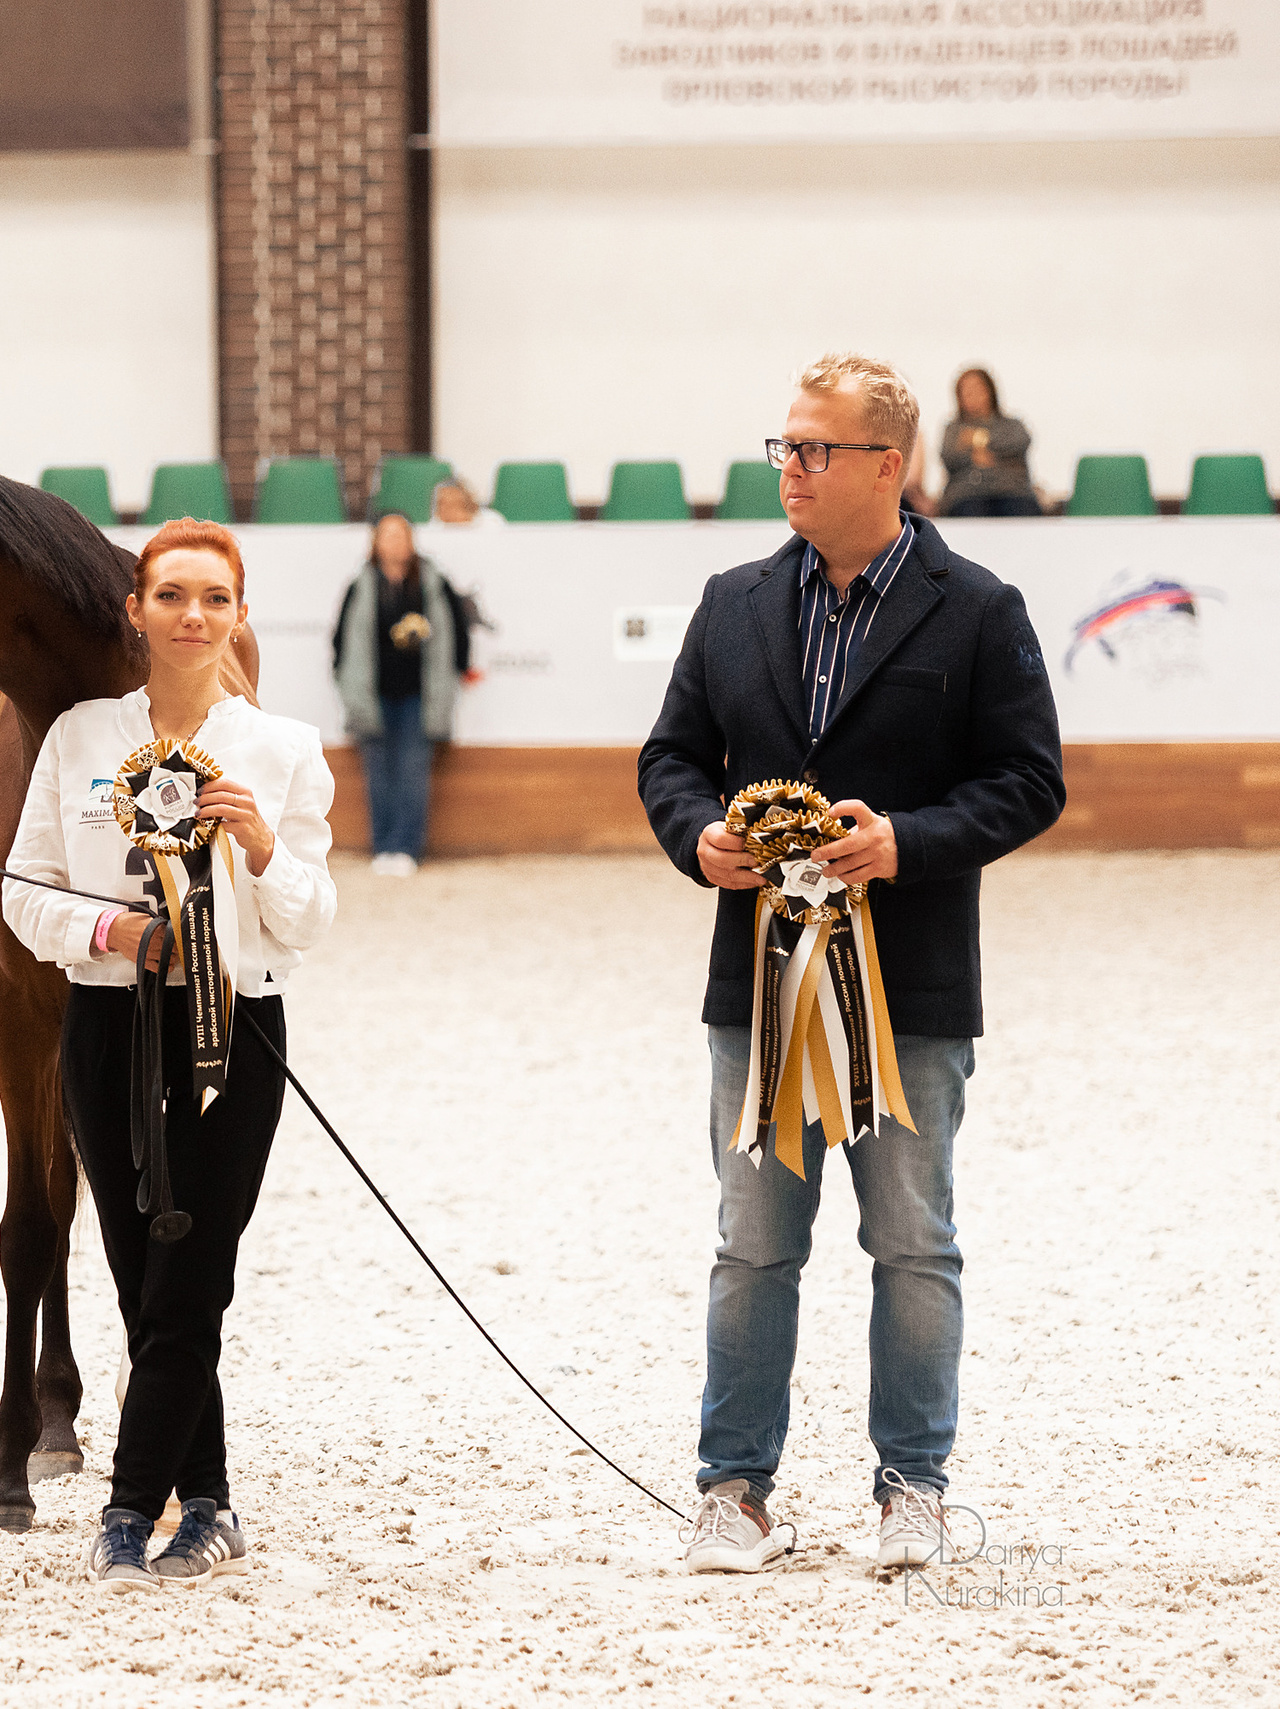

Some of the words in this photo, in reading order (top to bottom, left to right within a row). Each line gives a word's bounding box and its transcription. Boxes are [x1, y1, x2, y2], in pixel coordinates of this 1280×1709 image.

[186, 901, 197, 941] лошадей
[202, 907, 212, 942] породы
[191, 942, 199, 973] России
[202, 943, 216, 1006] чистокровной
[830, 943, 846, 982] лошадей
[845, 947, 856, 982] породы
[193, 974, 204, 1023] Чемпионат
[841, 982, 852, 1013] России
[196, 1024, 206, 1049] XVIII
[208, 1006, 220, 1048] арабской
